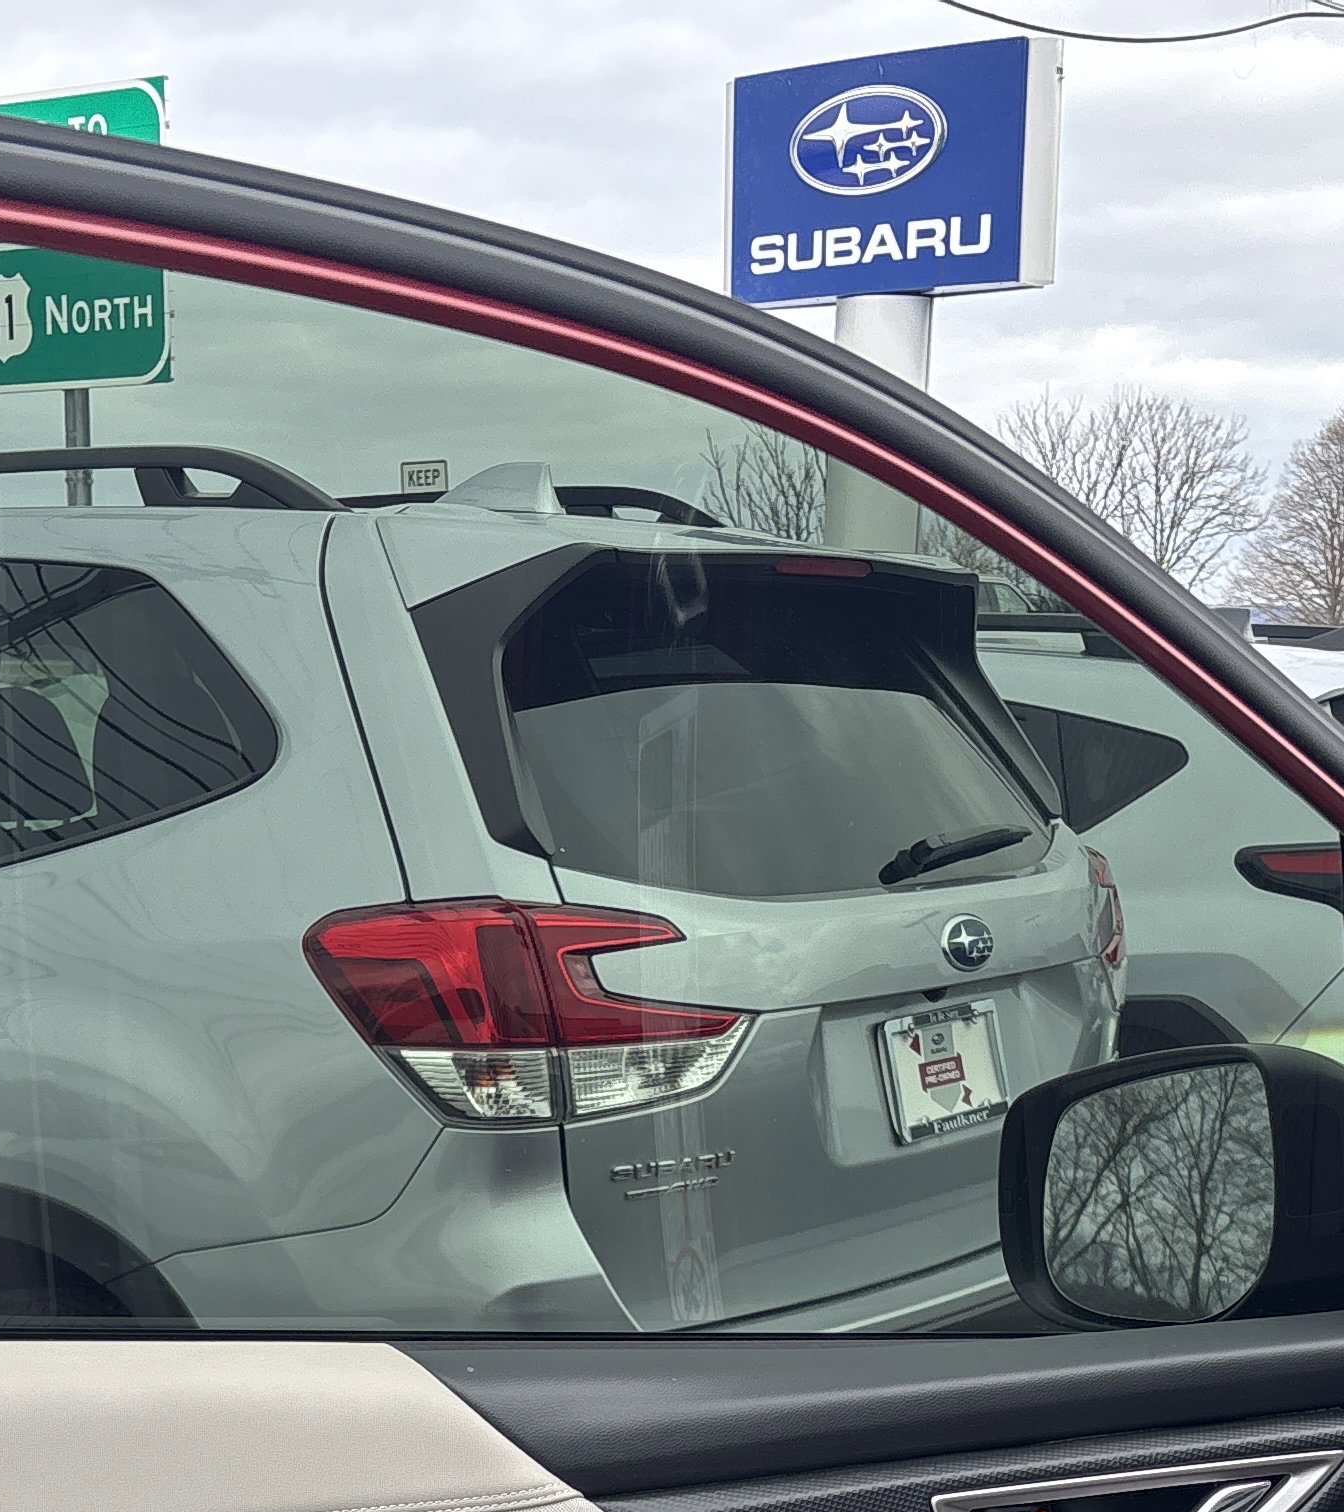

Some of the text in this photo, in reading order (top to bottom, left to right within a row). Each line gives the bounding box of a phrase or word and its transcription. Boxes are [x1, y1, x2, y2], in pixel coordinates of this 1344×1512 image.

[750, 213, 992, 275] SUBARU
[44, 294, 154, 336] NORTH
[407, 468, 441, 488] KEEP
[924, 1070, 961, 1086] PRE-OWNED
[925, 1061, 957, 1075] CERTIFIED
[933, 1109, 991, 1134] Faulkner
